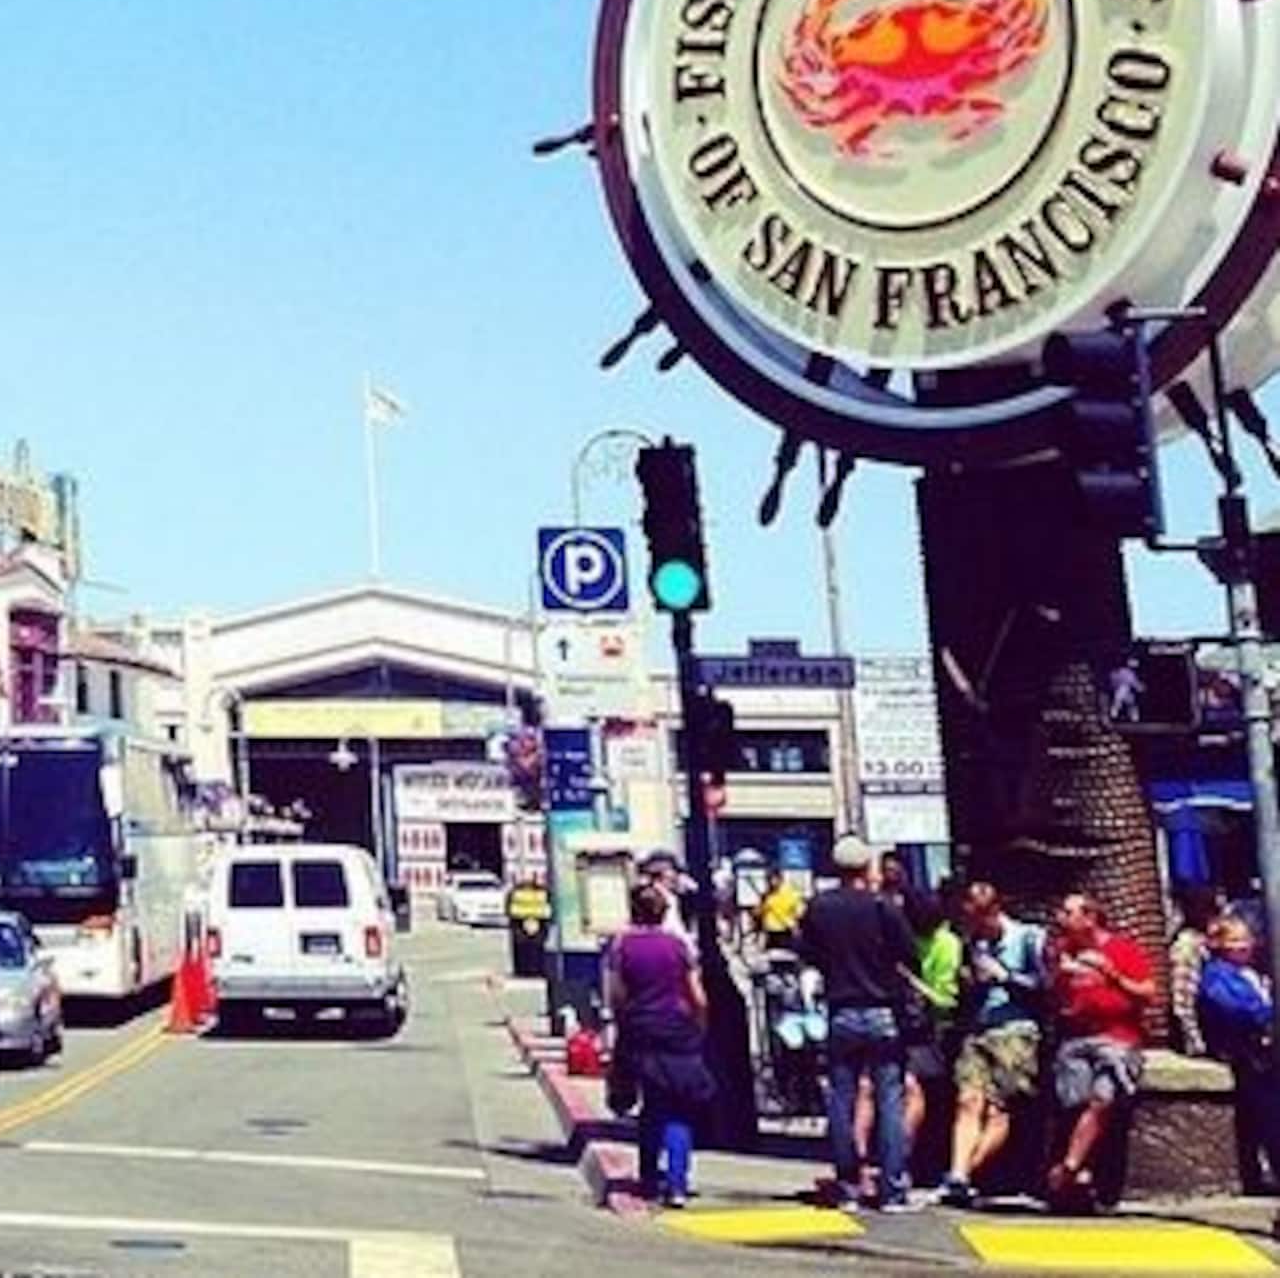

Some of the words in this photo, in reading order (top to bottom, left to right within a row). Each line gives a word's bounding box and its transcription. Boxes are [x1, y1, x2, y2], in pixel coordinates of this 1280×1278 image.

[687, 131, 759, 214] OF
[741, 210, 857, 320] SAN
[872, 47, 1174, 330] FRANCISCO
